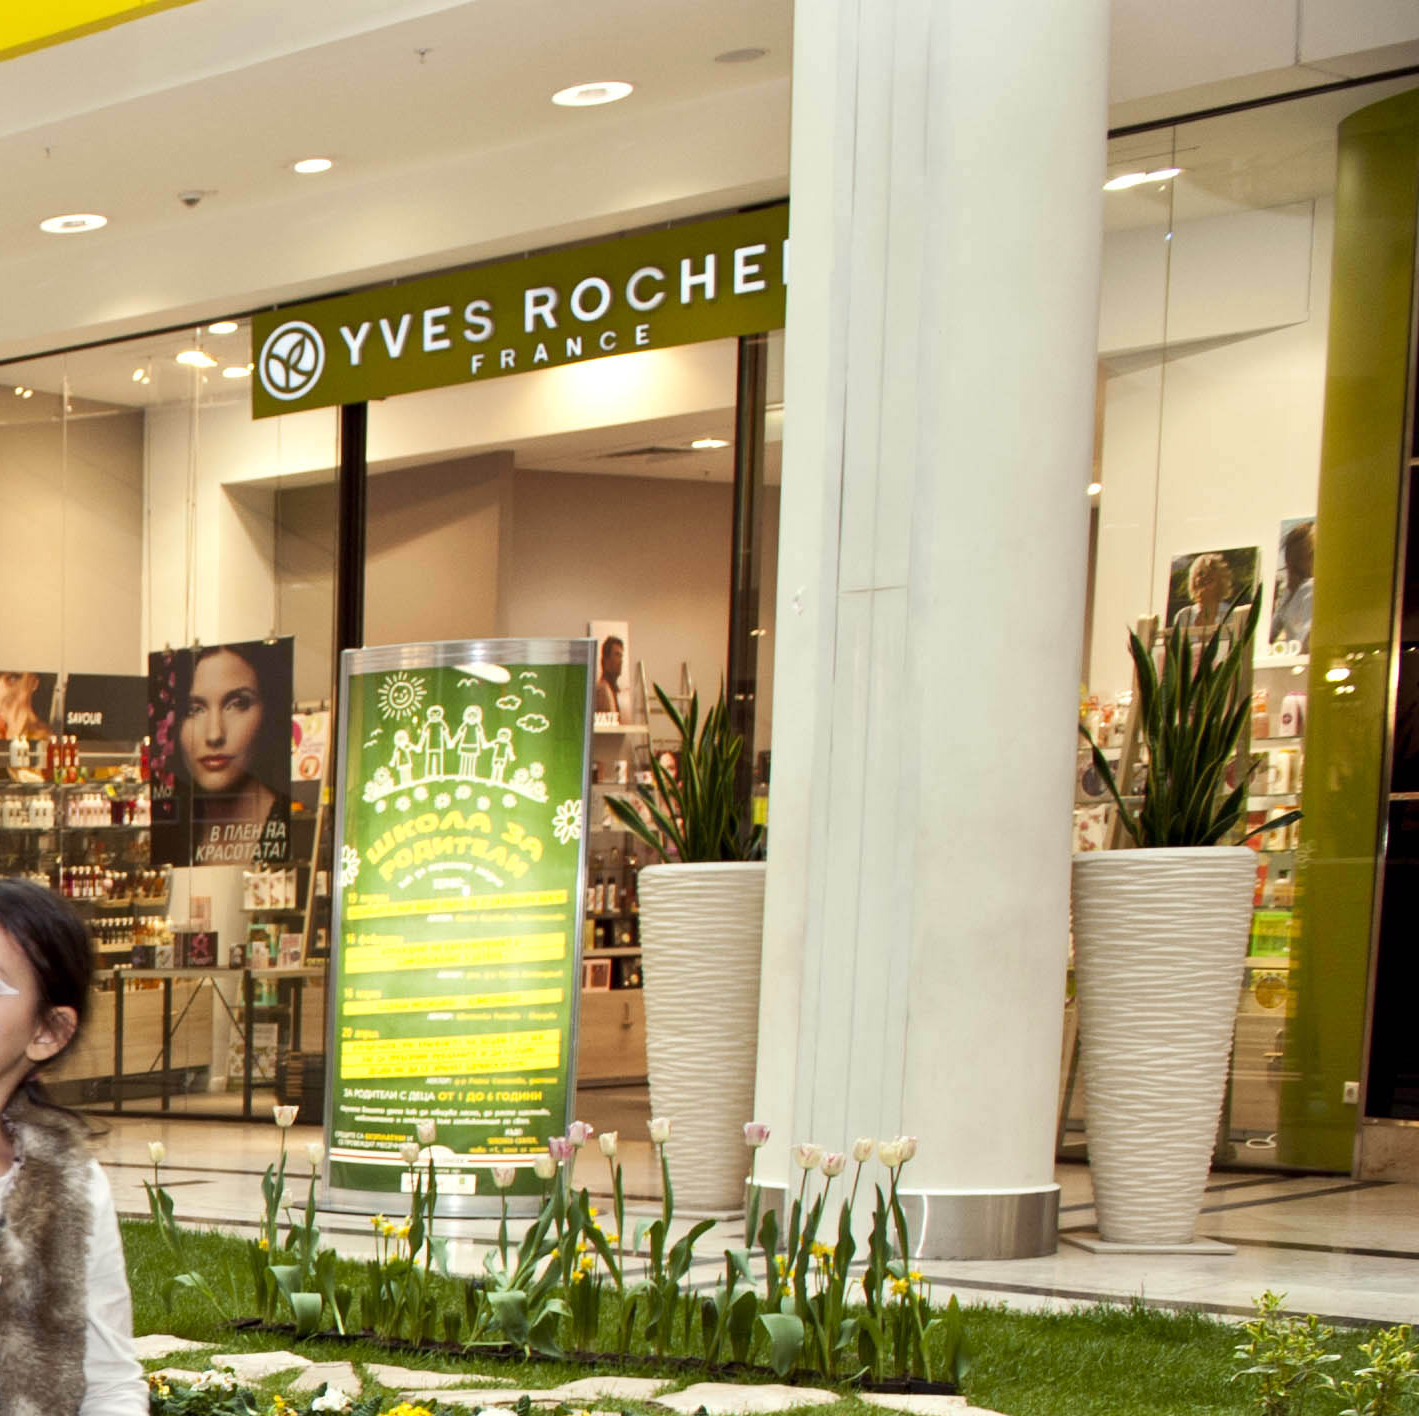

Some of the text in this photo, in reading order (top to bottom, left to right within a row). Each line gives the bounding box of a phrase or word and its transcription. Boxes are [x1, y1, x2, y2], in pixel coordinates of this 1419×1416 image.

[339, 299, 494, 366] YVES
[471, 324, 651, 374] FRANCE
[67, 711, 103, 726] SAVOUR
[210, 820, 286, 842] В ПЛЕН НА
[365, 809, 544, 866] ШКОЛА ЗА
[195, 841, 287, 861] КРАСОТАТА!
[378, 835, 531, 883] РОДИТЕЛИ
[438, 1091, 455, 1101] ОТ
[465, 1091, 485, 1103] ДО
[495, 1091, 543, 1102] ГОДИНИ
